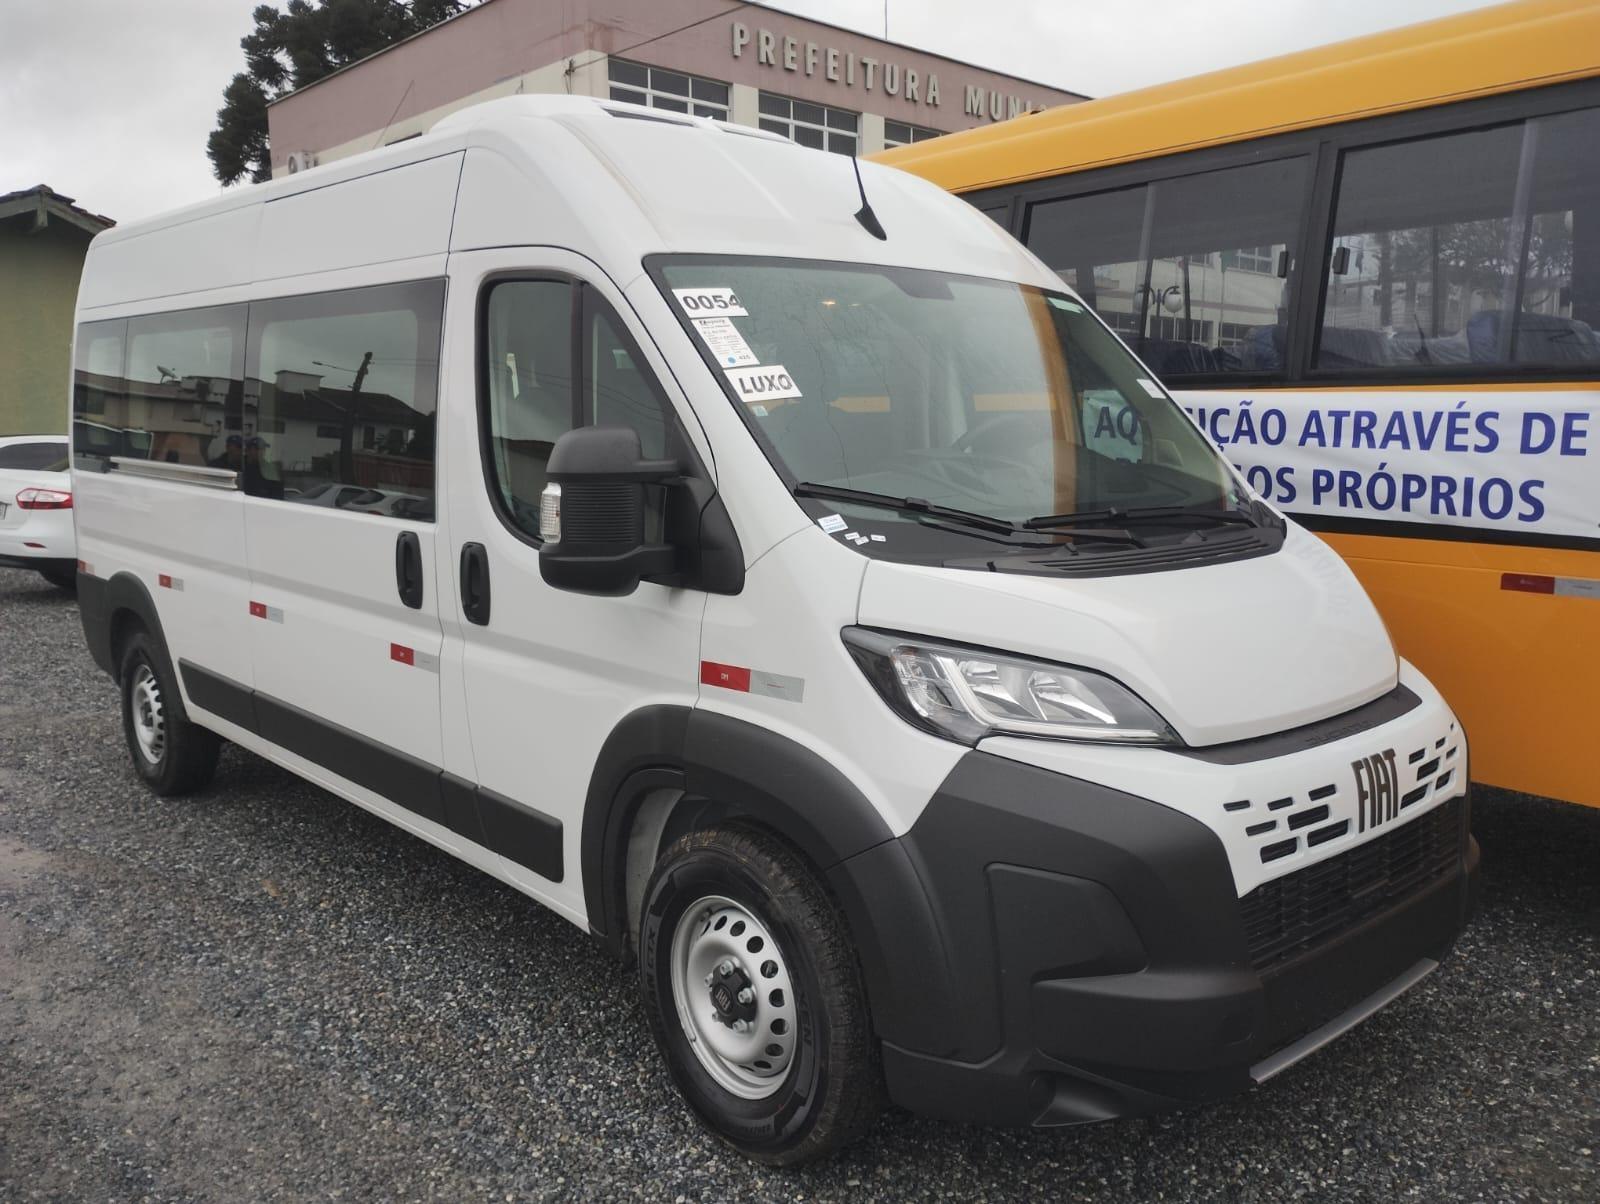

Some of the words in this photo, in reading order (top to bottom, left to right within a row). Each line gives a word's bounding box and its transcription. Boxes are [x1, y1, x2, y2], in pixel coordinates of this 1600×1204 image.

[732, 22, 941, 106] PREFEITURA
[682, 294, 743, 311] 0054
[738, 373, 794, 395] LUXO
[1298, 400, 1501, 454] ATRAVÉS
[1519, 411, 1591, 457] DE
[1312, 461, 1546, 523] PRÓPRIOS
[1350, 747, 1399, 834] FIAT
